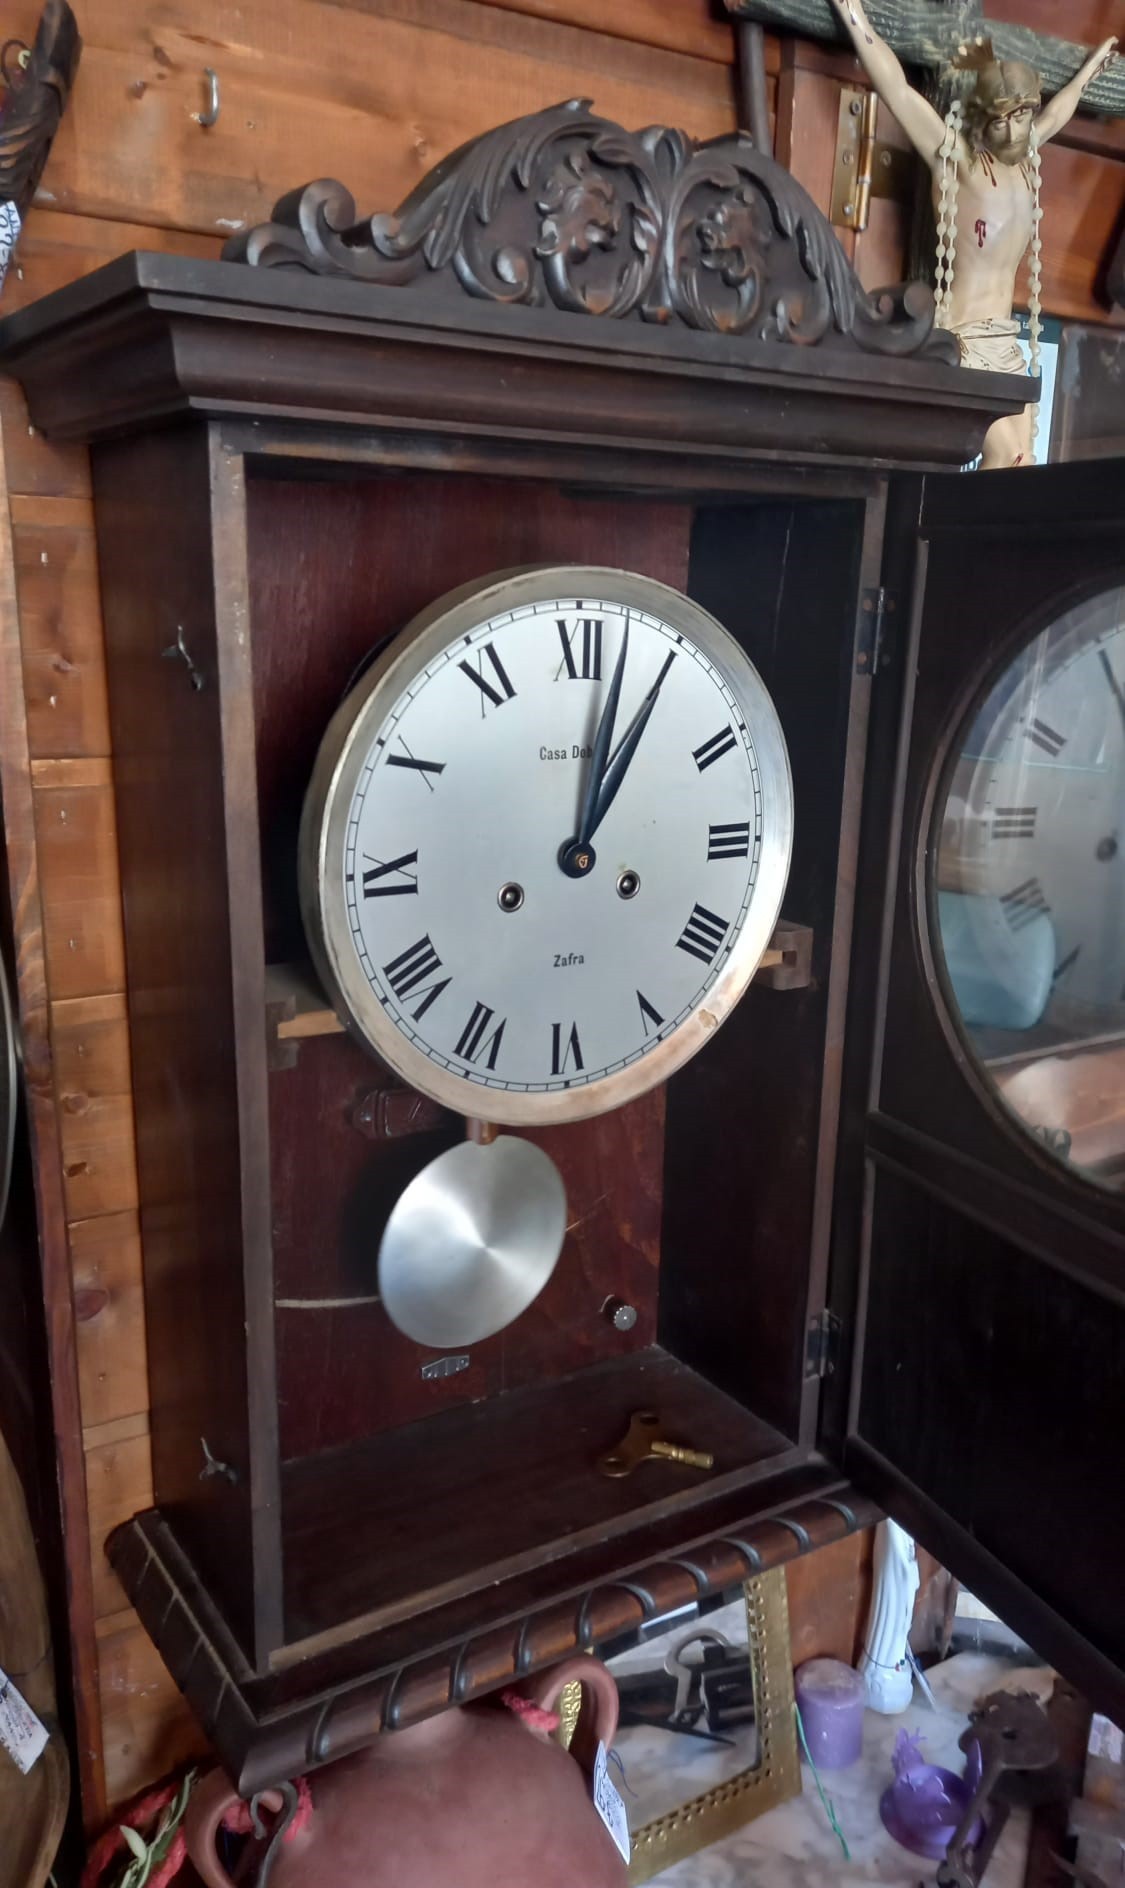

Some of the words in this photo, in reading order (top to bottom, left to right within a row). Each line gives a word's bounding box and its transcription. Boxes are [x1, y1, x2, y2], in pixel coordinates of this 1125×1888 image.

[553, 619, 604, 682] XII
[457, 641, 518, 719] XI
[386, 735, 447, 792] X
[539, 745, 567, 761] Casa
[572, 744, 596, 760] Dob
[691, 721, 738, 774] II
[706, 821, 750, 863] III
[362, 848, 419, 900] IX
[553, 952, 585, 968] Zafra
[675, 902, 731, 965] IIII
[382, 933, 453, 1023] VIII
[452, 1001, 507, 1071] VII
[636, 989, 665, 1037] V
[550, 1020, 585, 1076] VI
